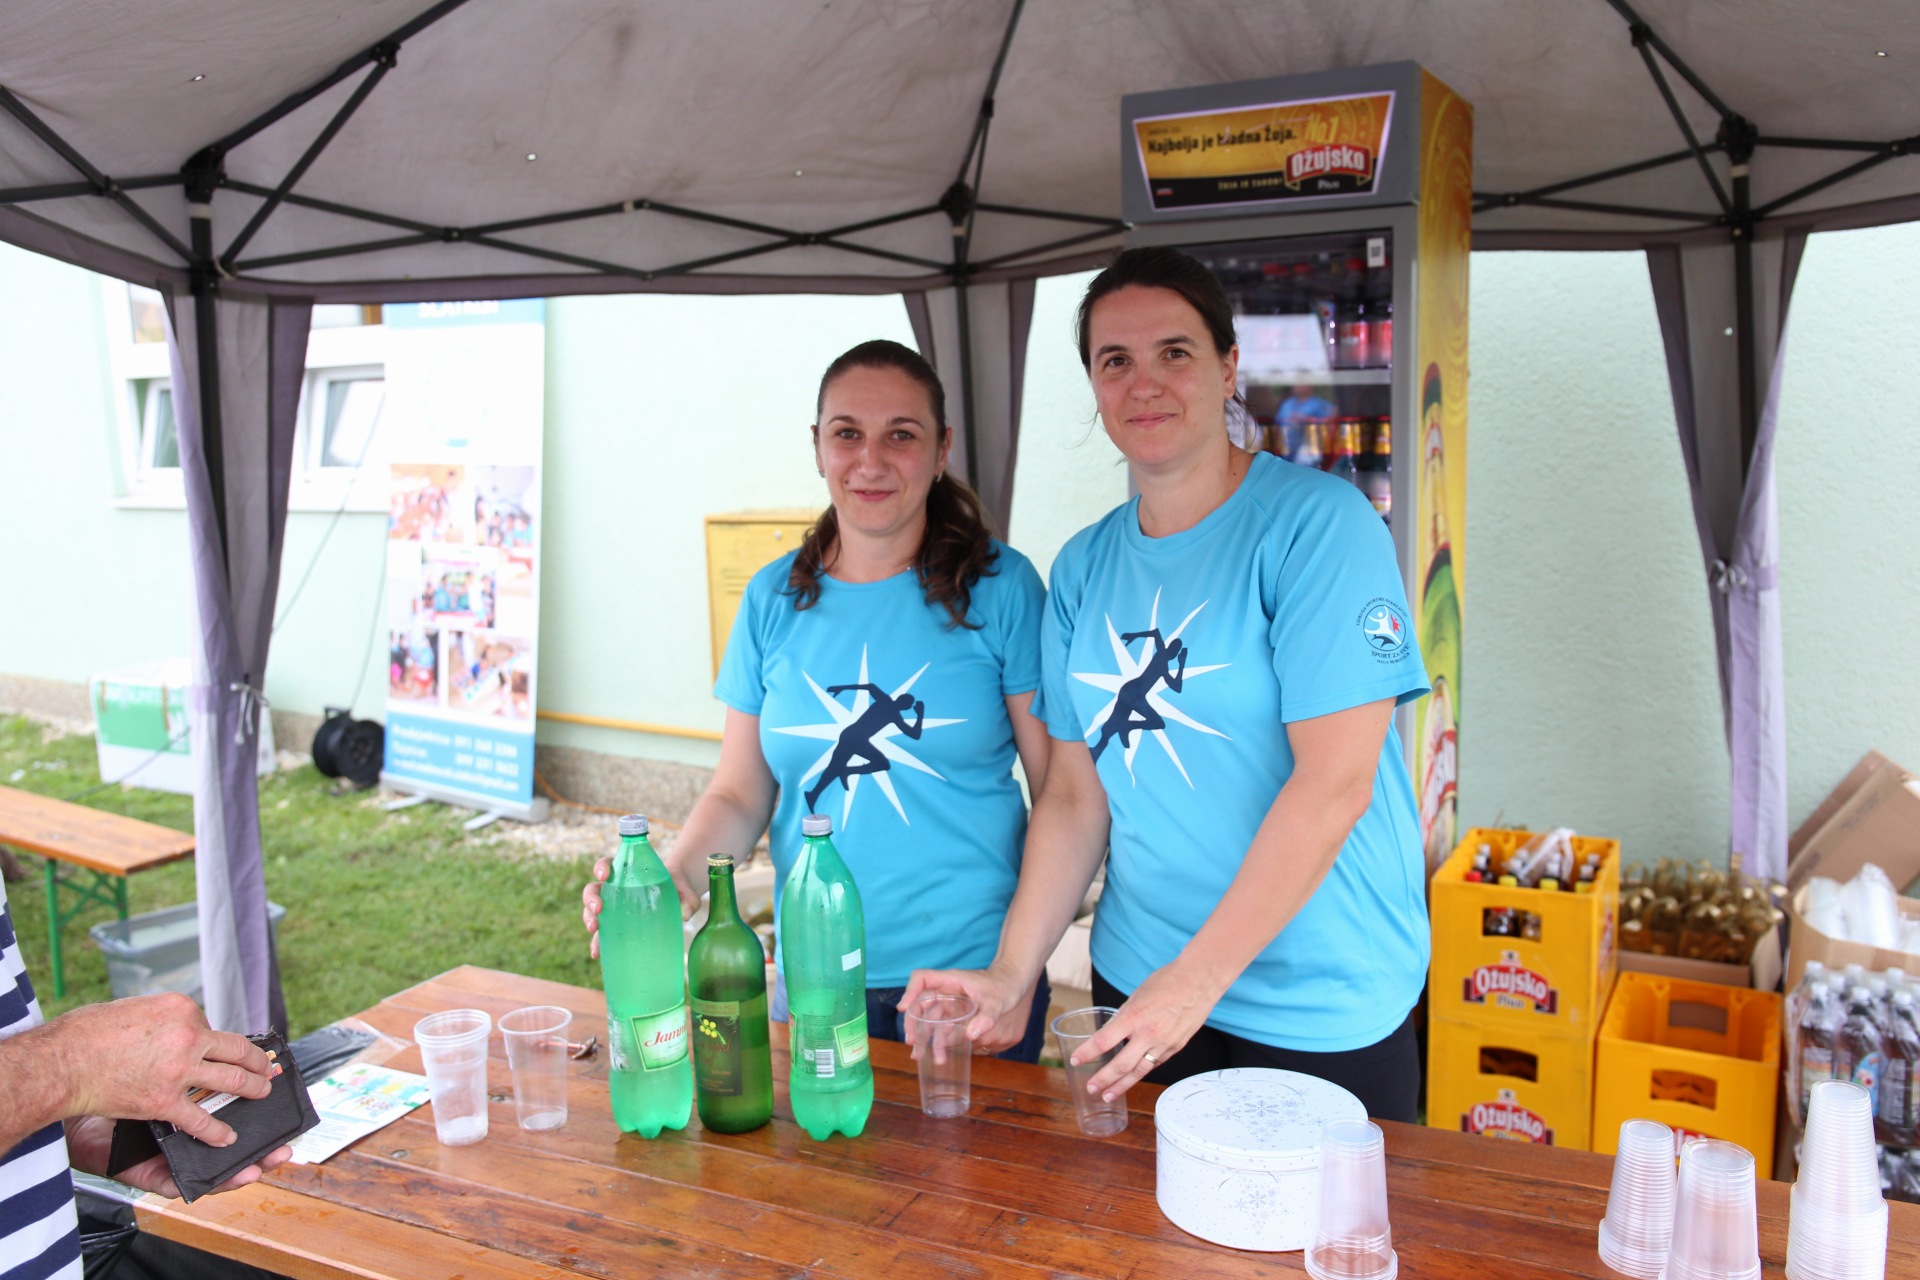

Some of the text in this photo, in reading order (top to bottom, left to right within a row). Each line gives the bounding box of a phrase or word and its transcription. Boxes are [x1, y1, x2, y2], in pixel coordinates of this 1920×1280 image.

[1148, 135, 1199, 156] Najbolja
[1202, 134, 1214, 151] je
[1291, 145, 1365, 177] Ožujsko
[1476, 967, 1547, 1000] Ožujsko
[1473, 1104, 1544, 1138] Ožujsko
